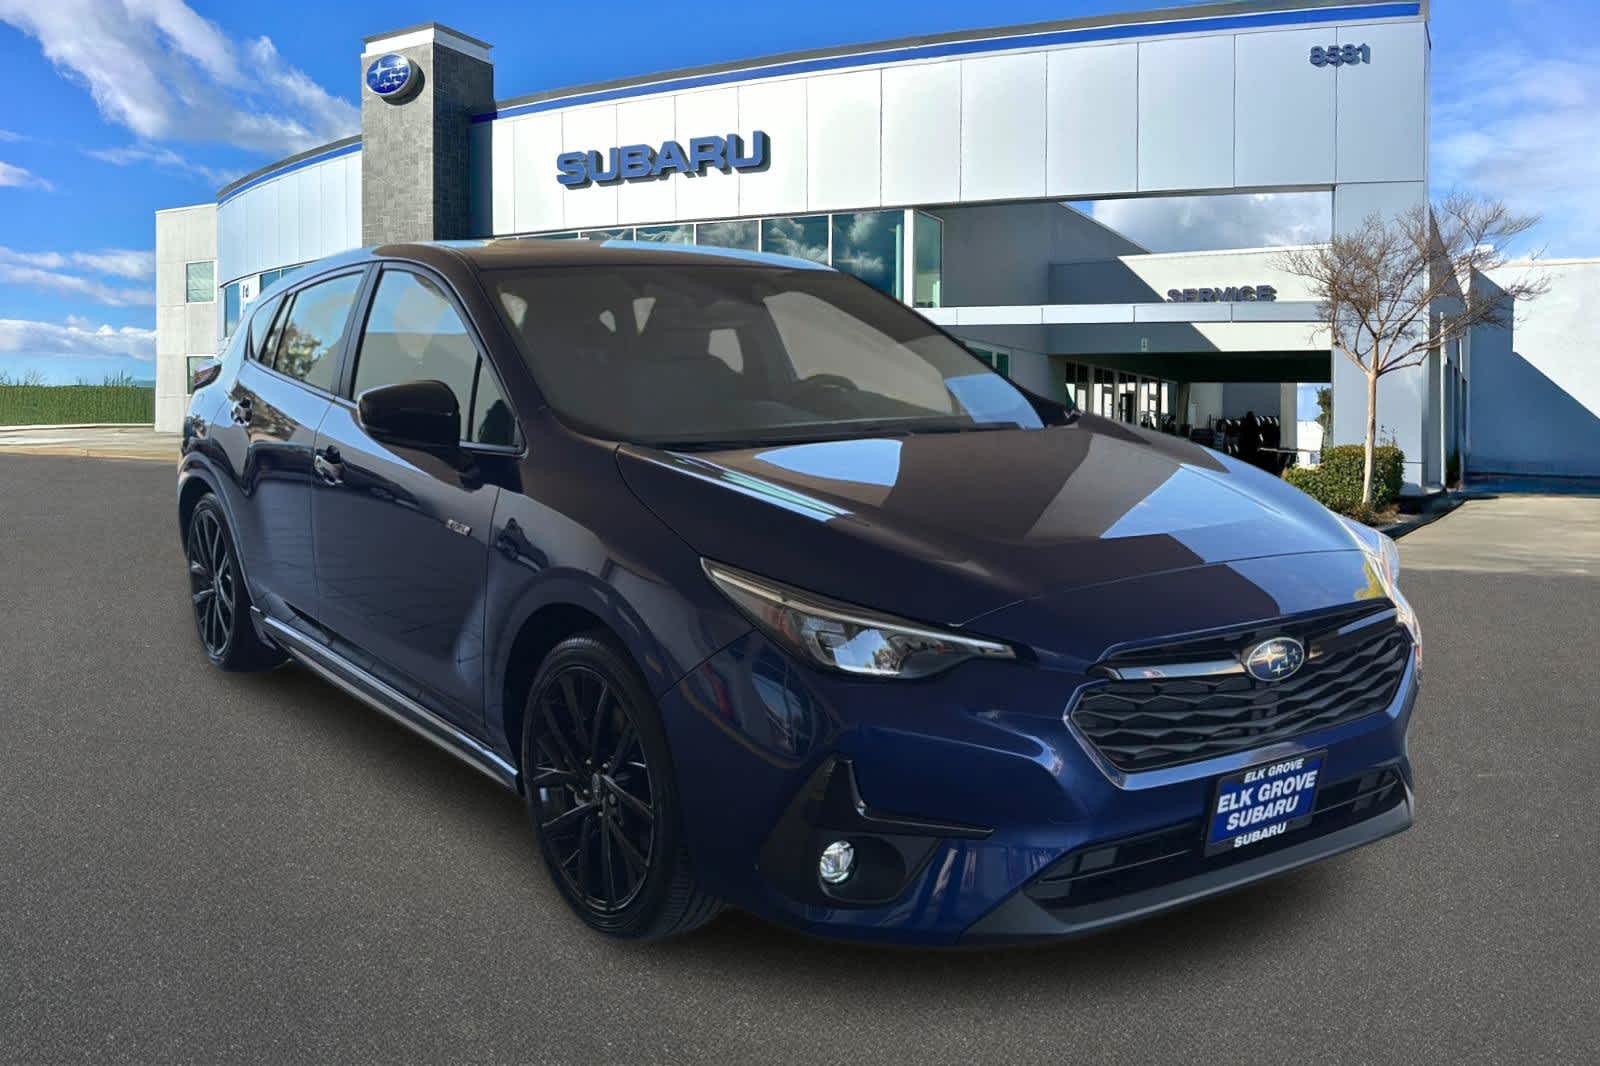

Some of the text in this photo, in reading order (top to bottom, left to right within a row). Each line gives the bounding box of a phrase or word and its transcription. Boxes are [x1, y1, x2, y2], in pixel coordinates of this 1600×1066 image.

[557, 130, 771, 189] SUBARU
[1166, 285, 1277, 302] SERVICE
[1244, 758, 1304, 784] ELK GROVE
[1217, 770, 1318, 814] ELK GROVE
[1226, 795, 1299, 831] SUBARU
[1233, 822, 1287, 848] SUBARU
